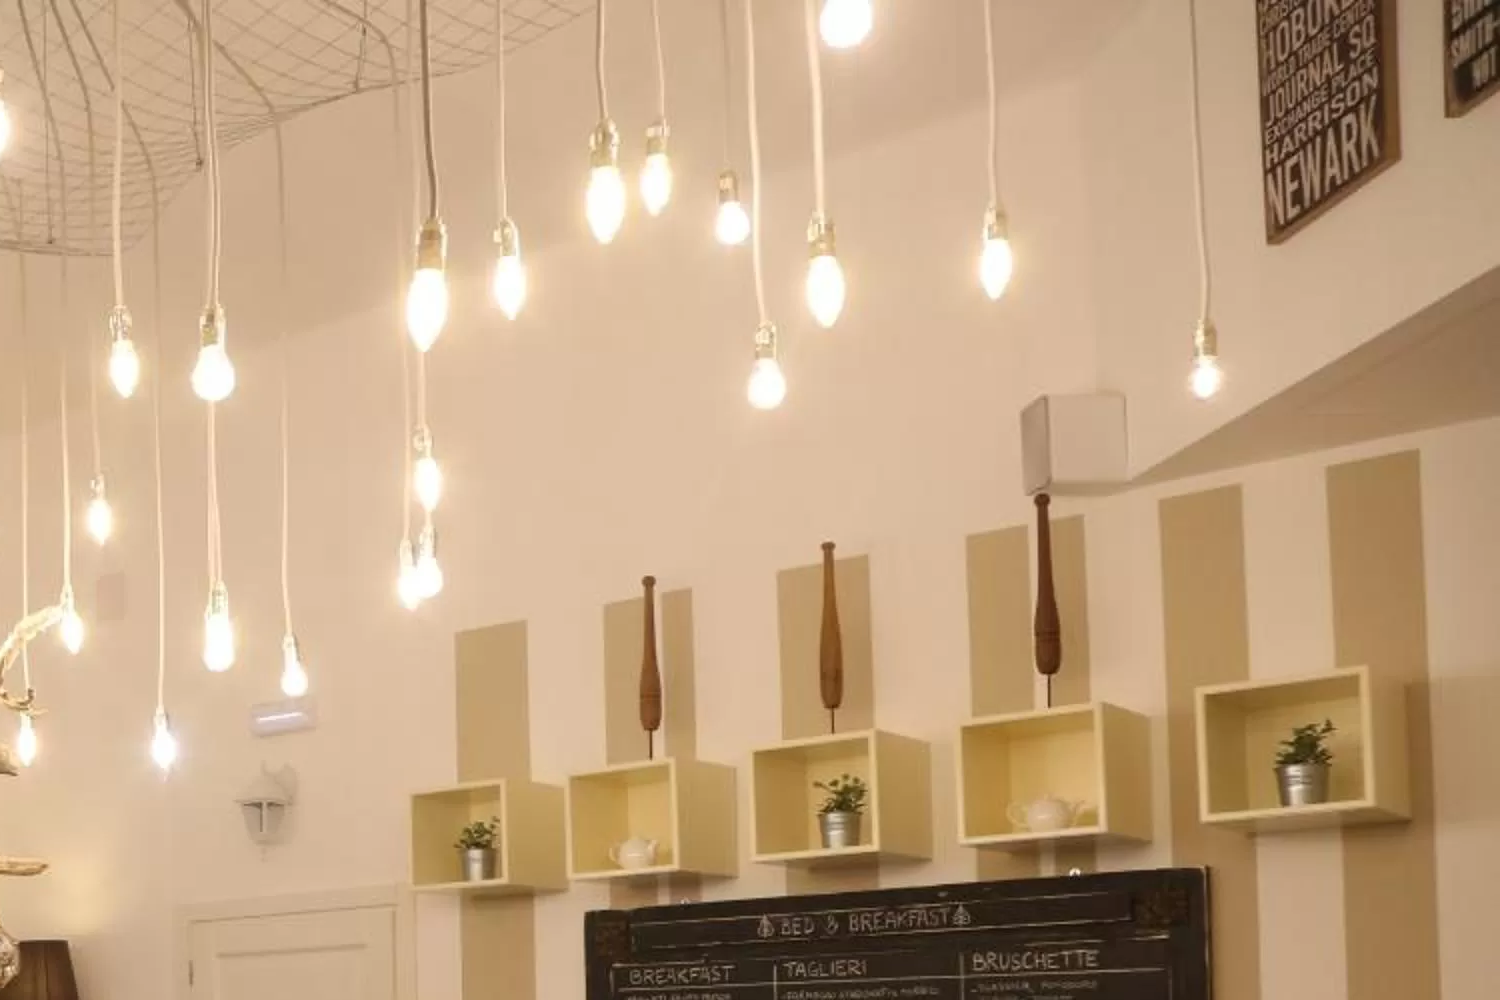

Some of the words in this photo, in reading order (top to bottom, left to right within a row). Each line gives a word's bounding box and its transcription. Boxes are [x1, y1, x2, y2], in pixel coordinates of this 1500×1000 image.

[1265, 42, 1345, 127] JOURNAL
[1348, 13, 1377, 59] SQ
[1265, 83, 1329, 145] EXCHANGE
[1331, 48, 1376, 96] PLACE
[1265, 66, 1378, 169] HARRISON
[1266, 93, 1380, 225] NEWARK
[780, 916, 815, 936] BED
[849, 908, 949, 933] BREAKFAST
[629, 965, 736, 985] BREAKFAST
[783, 959, 868, 977] TAGLIERI
[972, 950, 1100, 971] BRUSCHETTE
